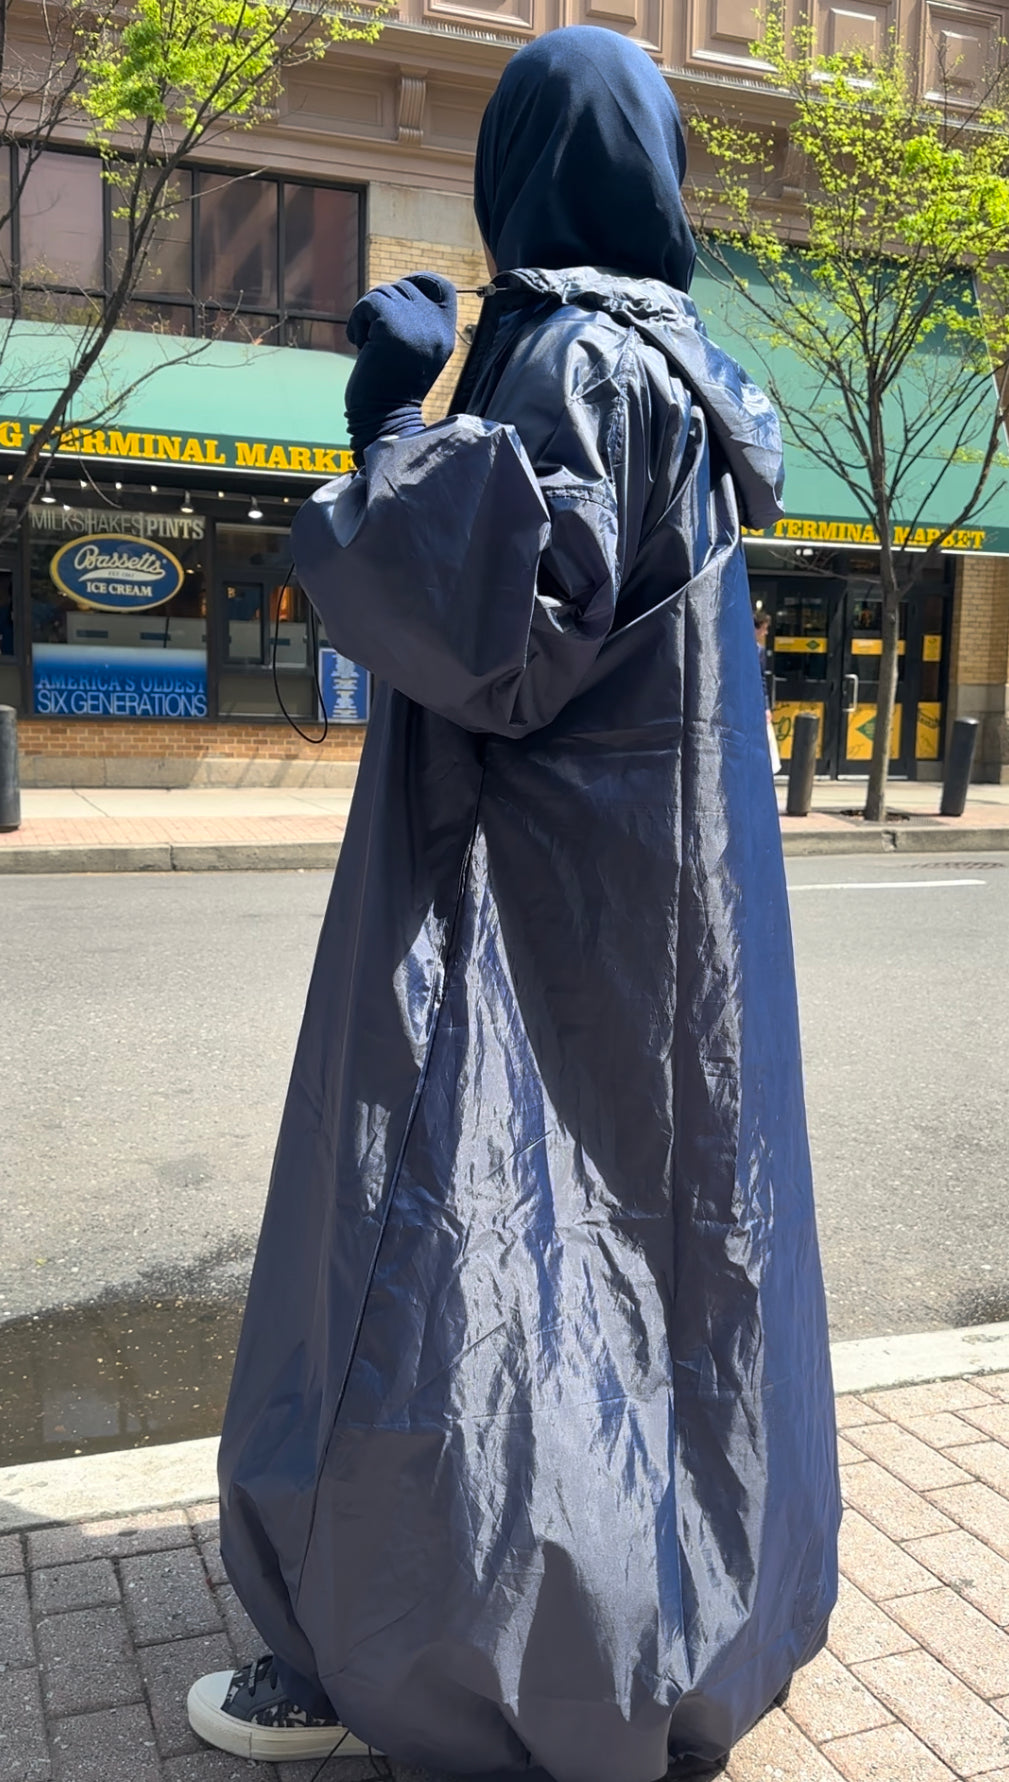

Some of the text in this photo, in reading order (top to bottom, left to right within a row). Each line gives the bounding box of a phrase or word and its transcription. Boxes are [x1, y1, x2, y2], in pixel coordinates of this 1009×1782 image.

[31, 510, 206, 540] MILKSHAKES PINTS
[773, 518, 882, 543] TERMINA
[74, 544, 163, 573] Bassetts
[86, 582, 152, 596] ICE CREAM
[36, 674, 136, 692] AMERICA'S
[37, 690, 207, 717] SIX GENERATIONS
